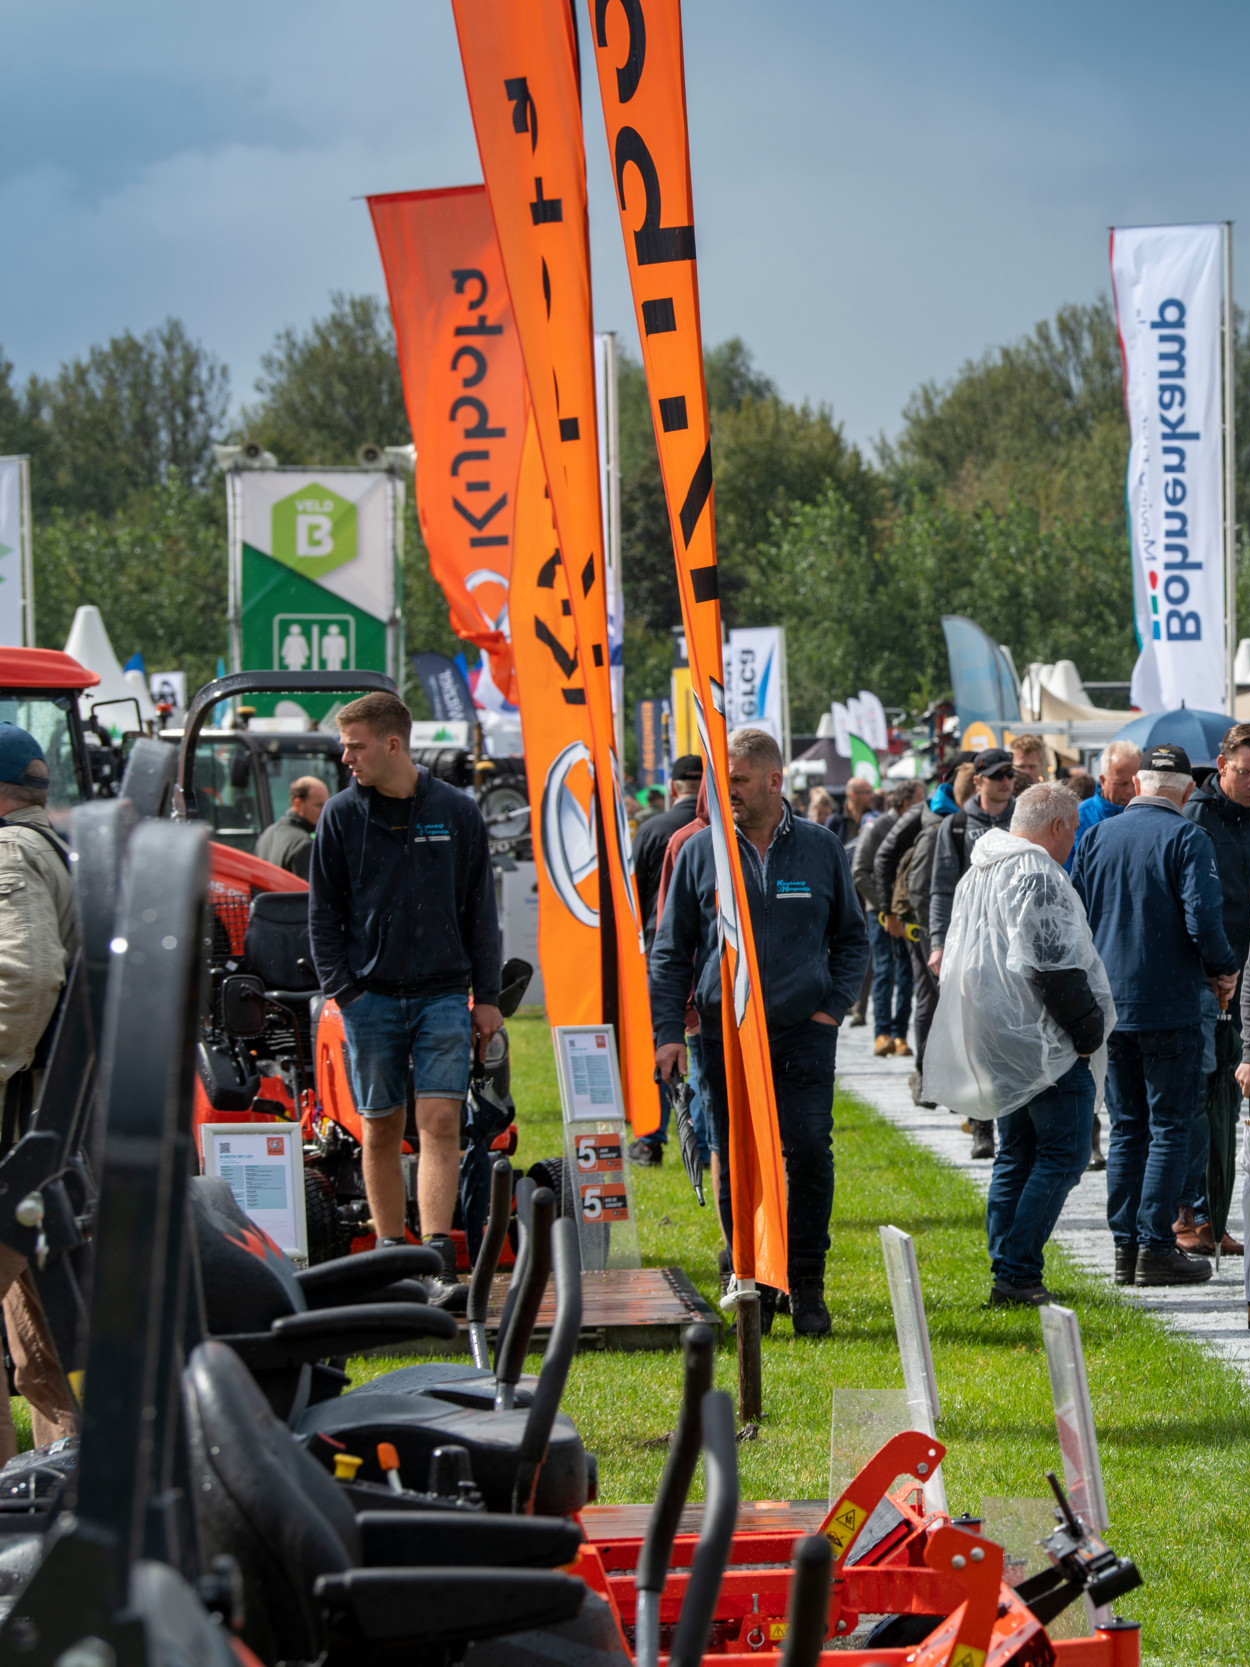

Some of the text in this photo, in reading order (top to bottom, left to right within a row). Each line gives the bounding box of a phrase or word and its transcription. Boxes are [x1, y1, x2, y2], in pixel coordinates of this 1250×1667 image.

[294, 499, 335, 512] VELD
[296, 513, 334, 557] B
[578, 1139, 597, 1168] 5
[583, 1188, 602, 1218] 5
